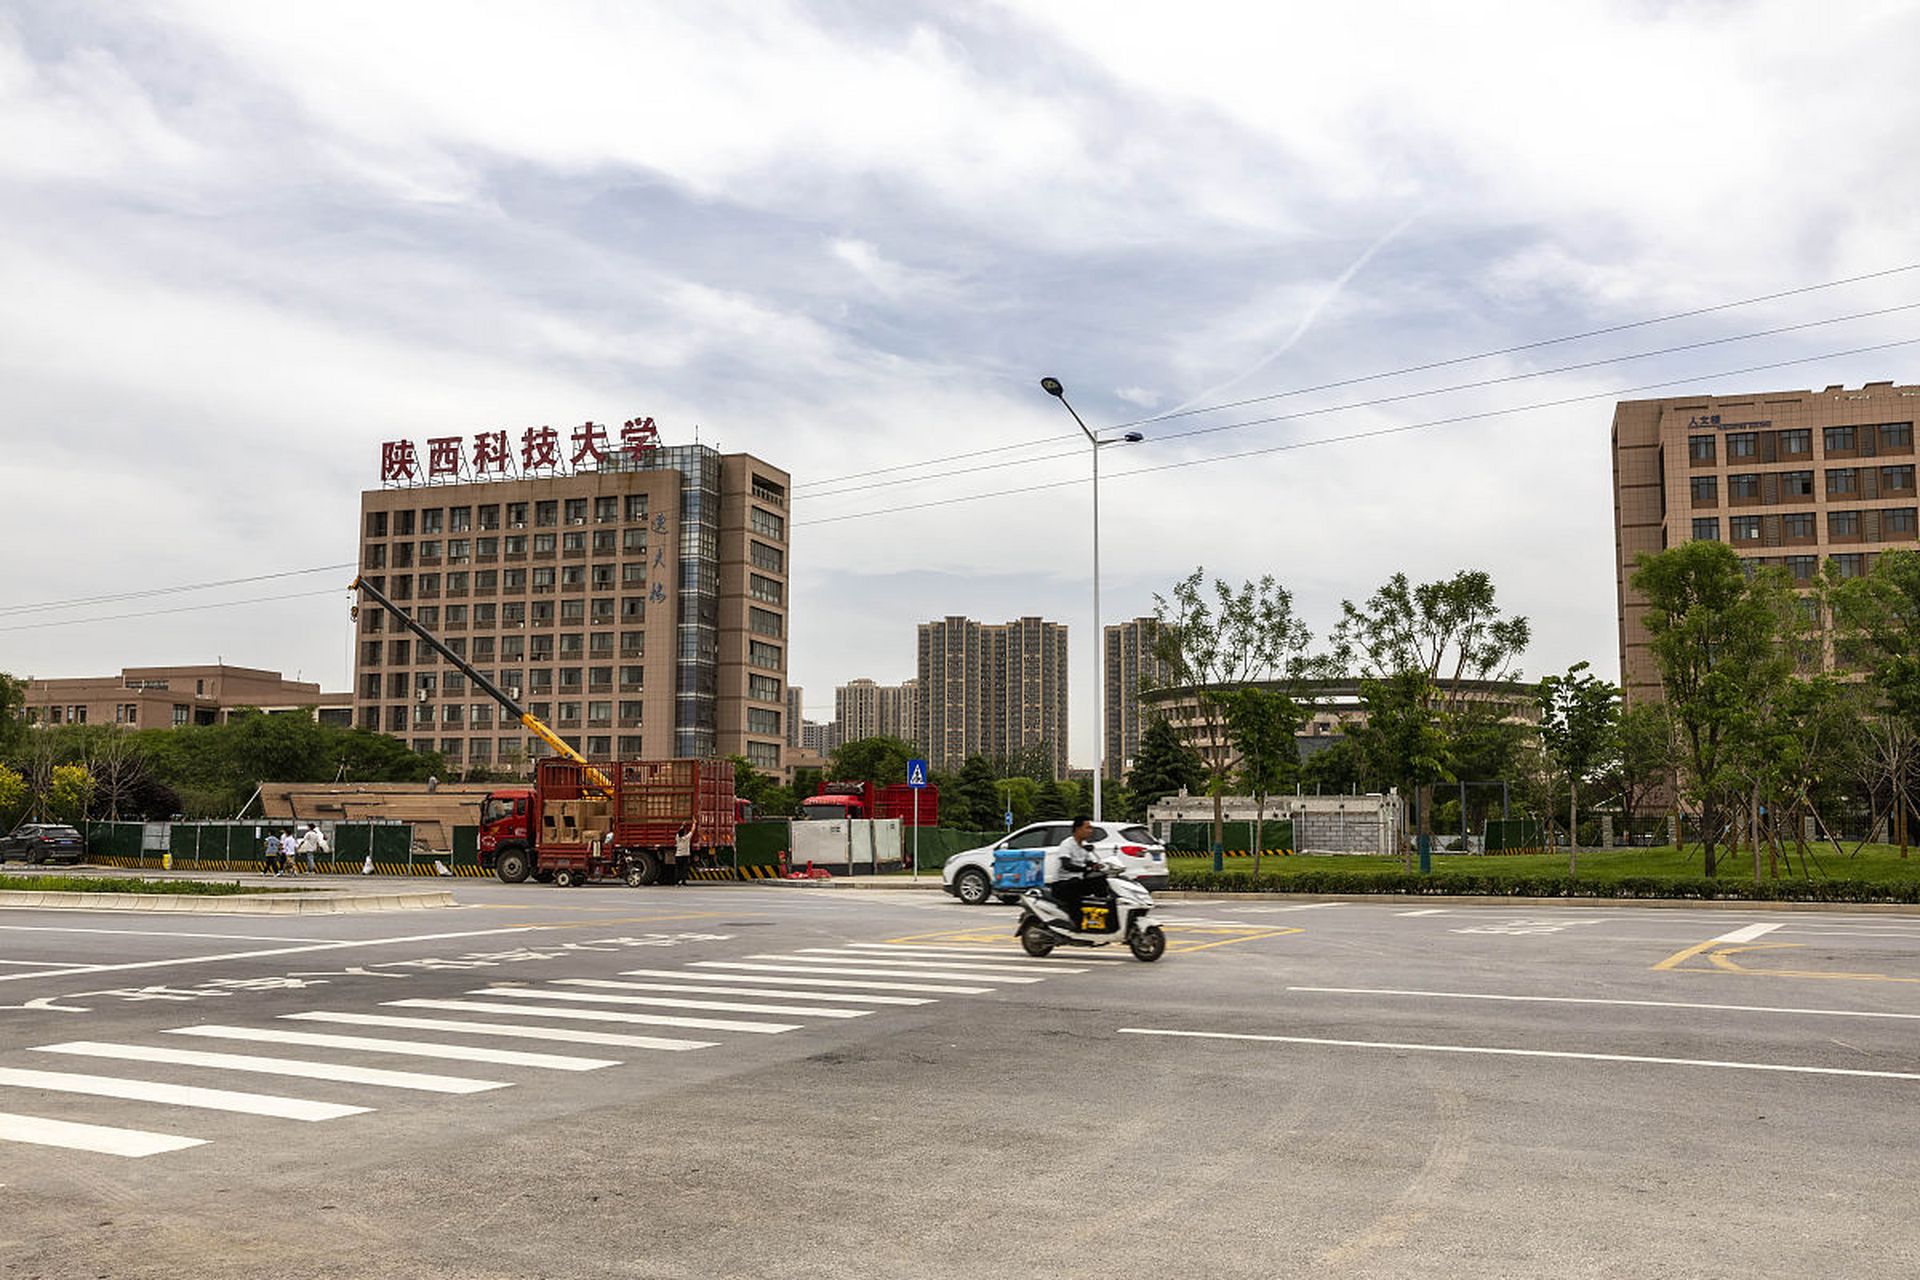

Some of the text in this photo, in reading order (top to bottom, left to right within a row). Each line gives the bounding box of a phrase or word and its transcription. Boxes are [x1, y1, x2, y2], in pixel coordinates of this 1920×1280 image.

[380, 417, 658, 481] 陕西科技大学
